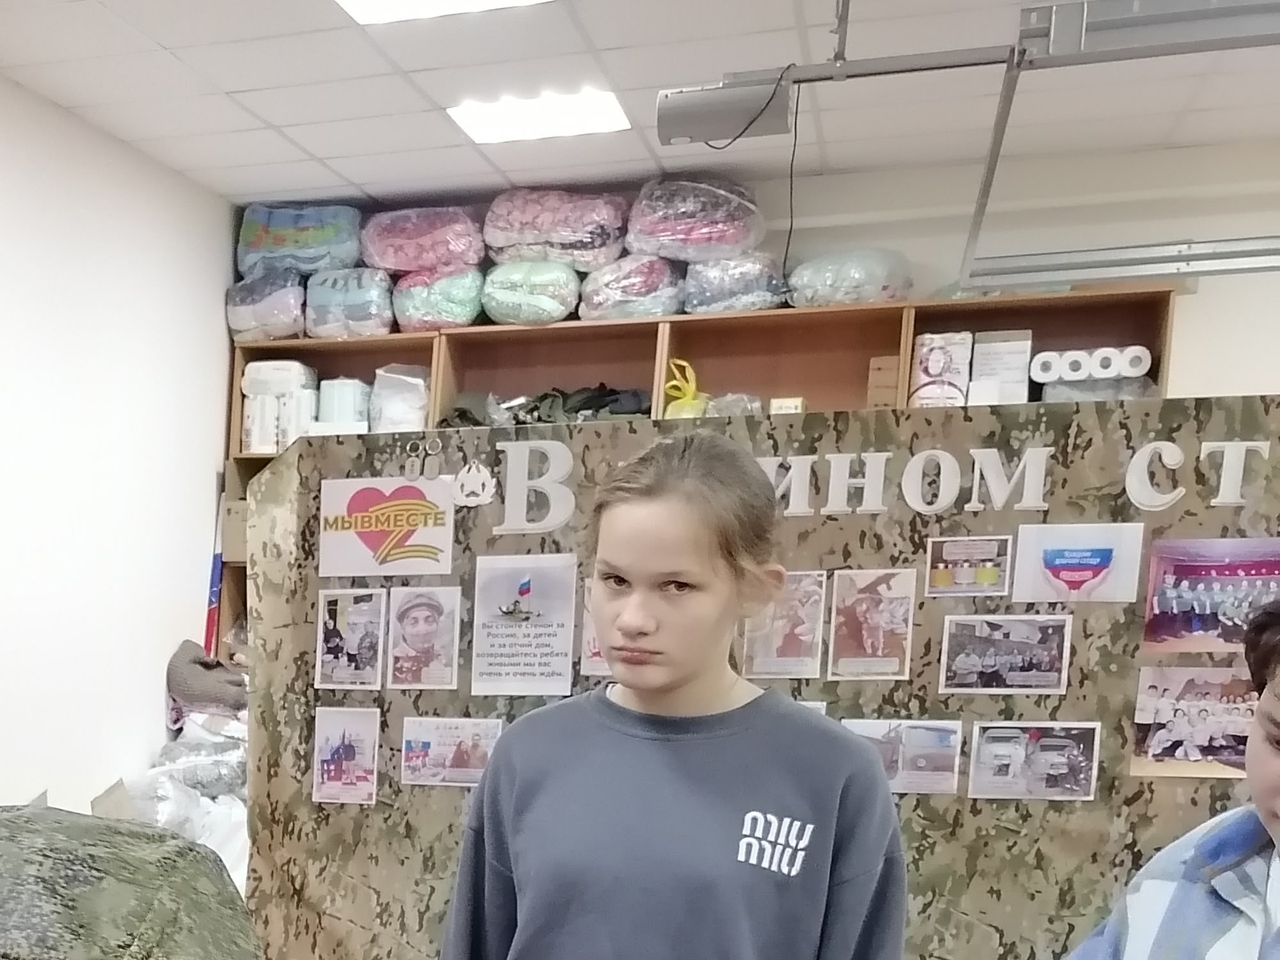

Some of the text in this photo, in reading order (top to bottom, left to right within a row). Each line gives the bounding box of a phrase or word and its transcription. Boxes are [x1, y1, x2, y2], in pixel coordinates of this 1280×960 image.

[493, 440, 1271, 536] В ИНОМ СТ
